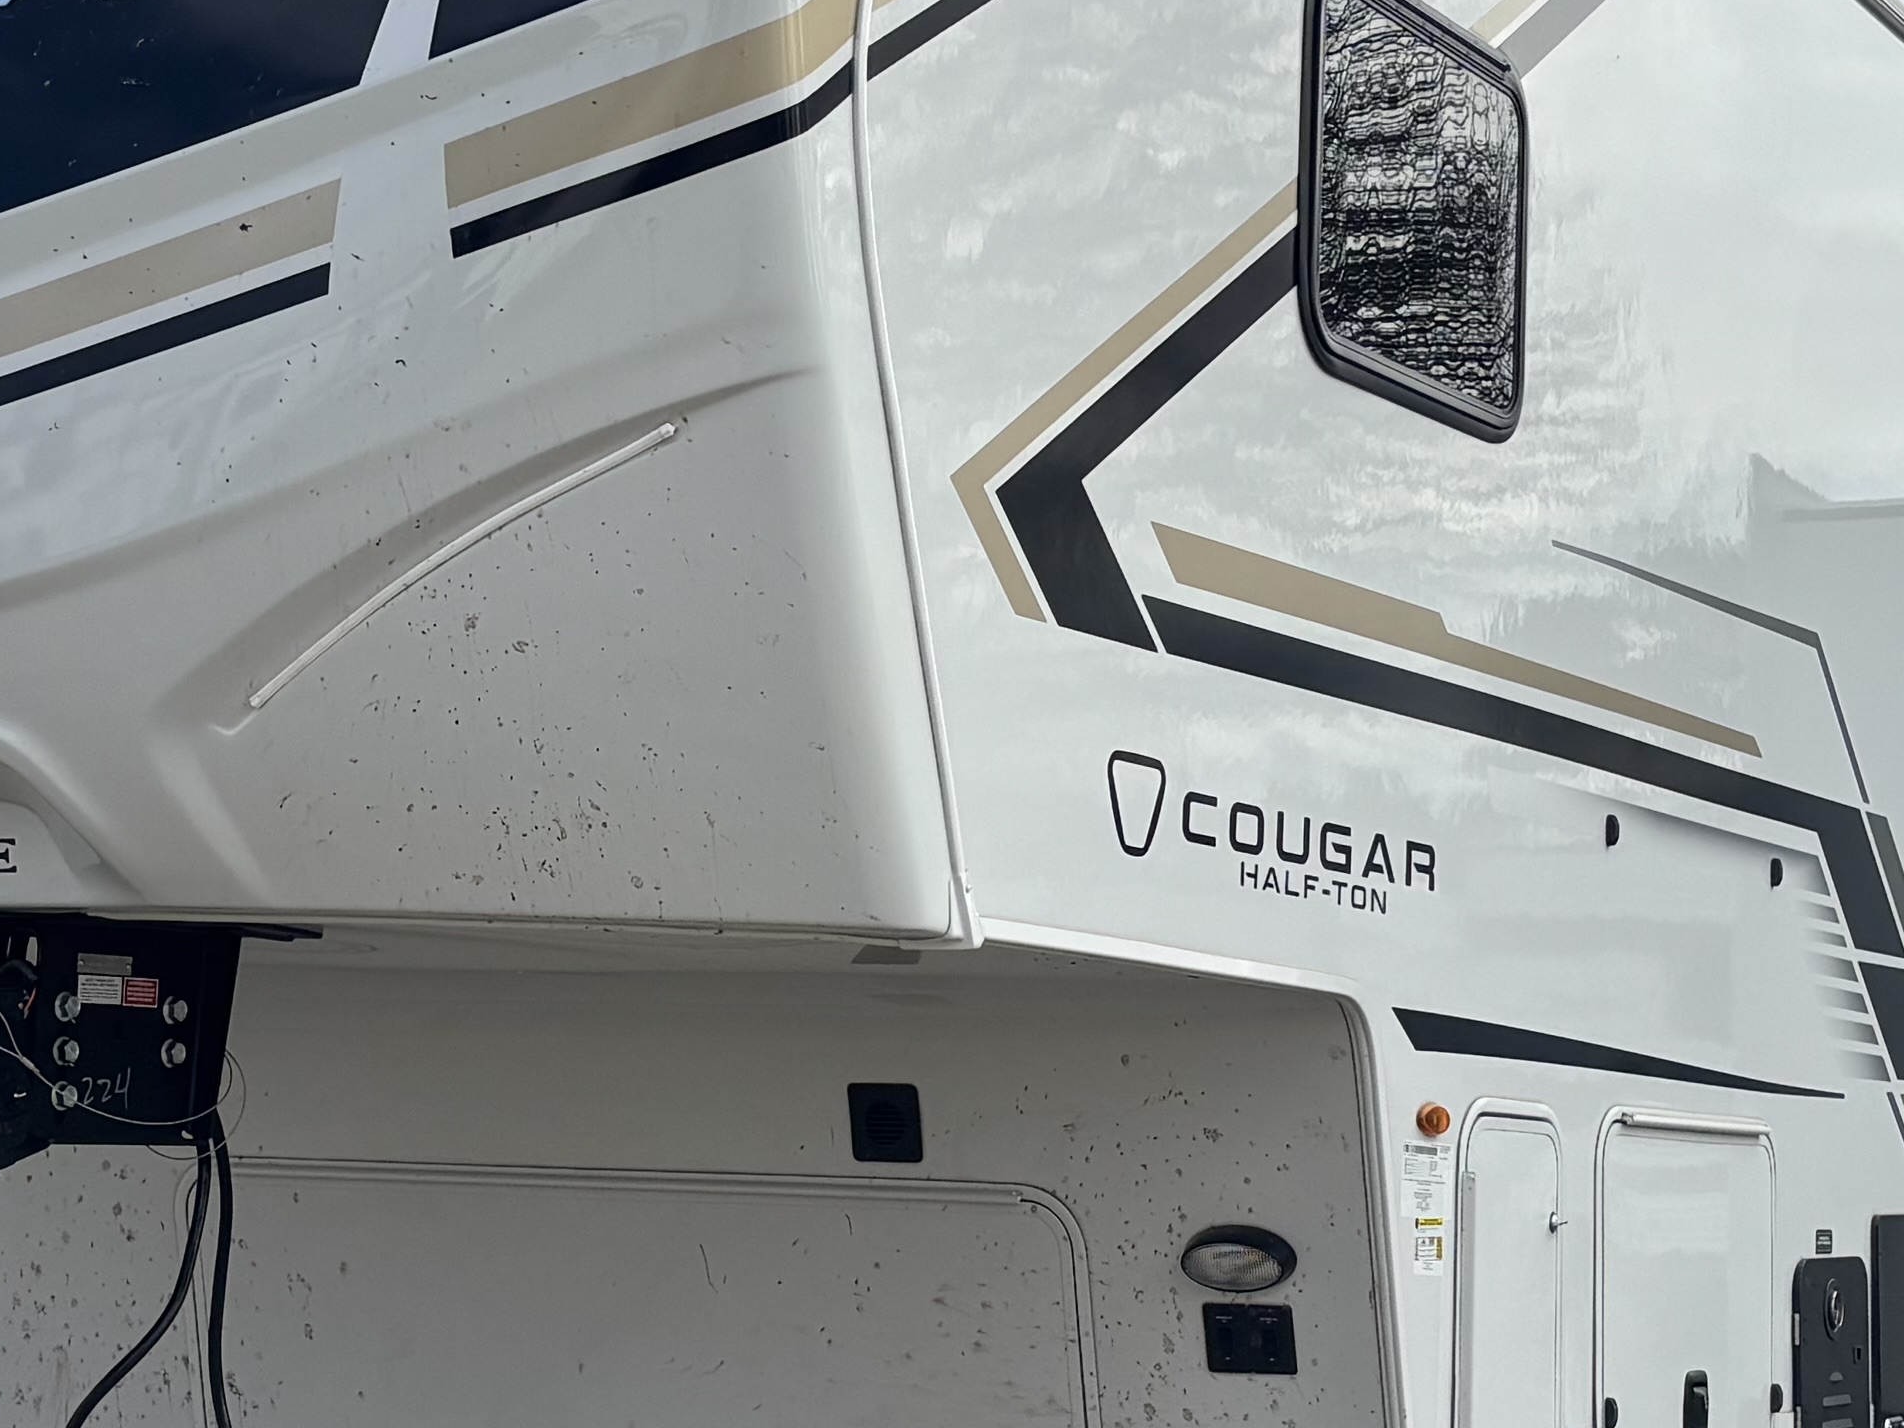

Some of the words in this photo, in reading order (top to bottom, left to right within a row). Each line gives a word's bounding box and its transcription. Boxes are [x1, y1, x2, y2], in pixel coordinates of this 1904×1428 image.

[1181, 790, 1436, 892] COUGAR
[1240, 860, 1387, 915] HALF-TON
[81, 1066, 131, 1111] 224
